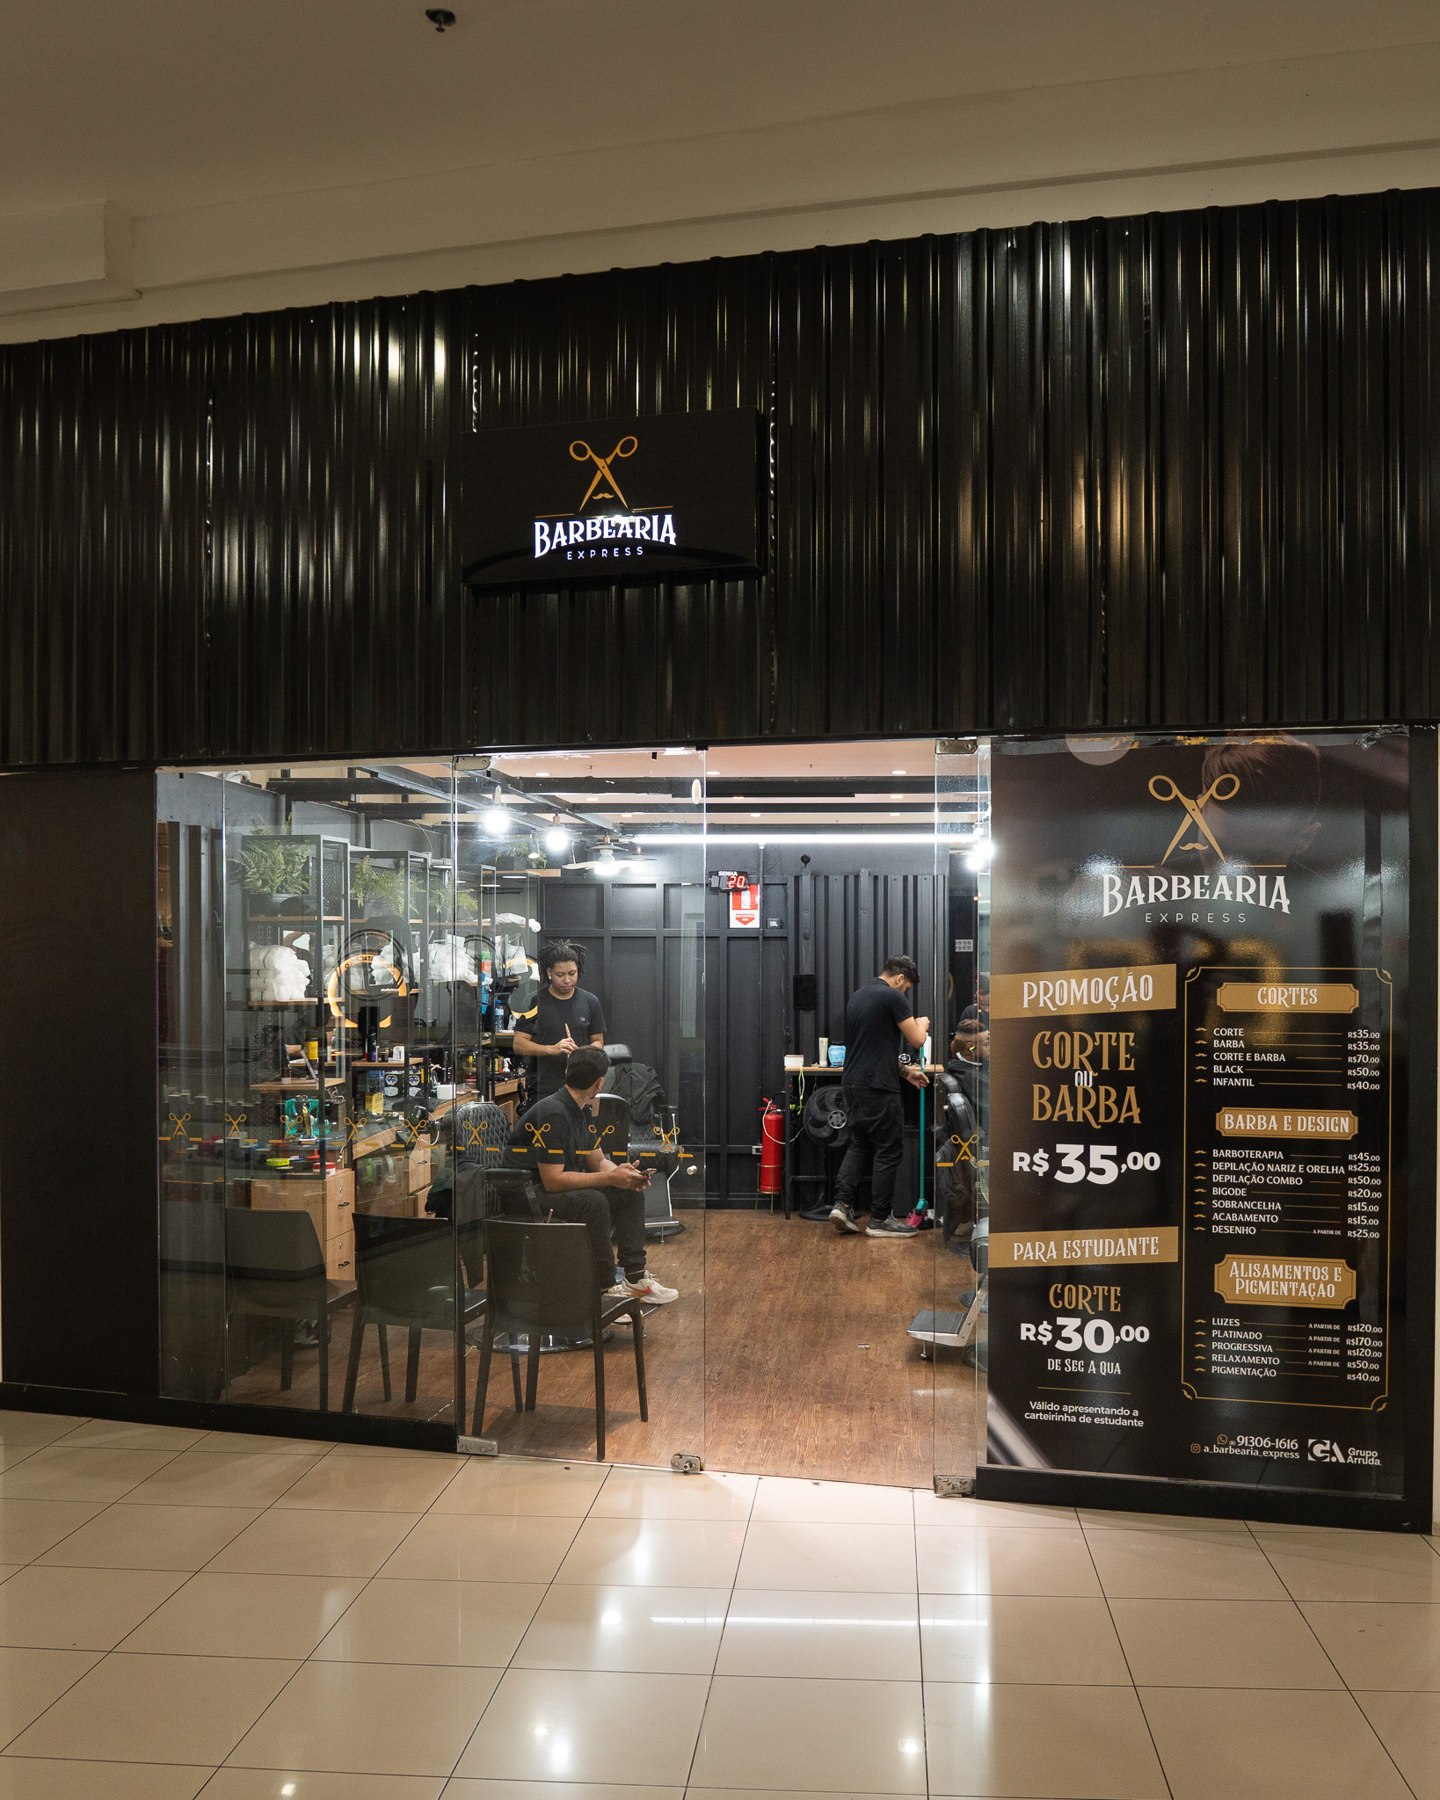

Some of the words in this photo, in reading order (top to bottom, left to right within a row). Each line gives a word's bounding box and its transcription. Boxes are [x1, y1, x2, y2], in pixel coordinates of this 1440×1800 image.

[534, 514, 677, 559] BARBEARIA
[566, 546, 643, 560] EXPRESS
[728, 876, 746, 888] 20
[1102, 874, 1291, 918] BARBEARIA
[1145, 912, 1246, 923] EXPRESS
[1257, 987, 1318, 1008] CORTES
[1213, 1028, 1244, 1037] CORTE
[1213, 1040, 1245, 1049] BARBA
[1032, 1031, 1135, 1076] CORTE
[1213, 1053, 1244, 1061] CORTE
[1246, 1053, 1252, 1061] E
[1254, 1053, 1286, 1062] BARBA
[1213, 1065, 1244, 1074] BLACK
[1074, 1070, 1093, 1088] OU
[1213, 1078, 1255, 1087] INFANTIL
[1032, 1083, 1142, 1129] BARBA
[1224, 1114, 1278, 1131] BARBA
[1283, 1115, 1292, 1131] E
[1297, 1116, 1350, 1133] DESIGN
[1212, 1149, 1284, 1160] BARBOTERAPIA
[1212, 1162, 1265, 1173] DEPILAÇÃO
[1267, 1164, 1296, 1173] NARIZ
[1299, 1165, 1304, 1173] E
[1306, 1165, 1345, 1175] ORELHA
[1212, 1174, 1265, 1185] DEPILAÇÃO
[1266, 1176, 1303, 1185] COMBO
[1212, 1187, 1247, 1197] BIGODE
[1212, 1200, 1282, 1211] SOBRANCELHA
[1212, 1212, 1279, 1223] ACABAMENTO
[1212, 1225, 1256, 1235] DESENHO
[1013, 1241, 1057, 1263] PARA
[1063, 1236, 1159, 1259] ESTUDANTE
[1229, 1261, 1329, 1281] ALISAMENTOS
[1334, 1267, 1342, 1282] E
[1049, 1284, 1121, 1315] CORTE
[1212, 1318, 1240, 1327] LUZES
[1020, 1316, 1150, 1354] R$30,00
[1212, 1330, 1263, 1340] PLATINADO
[1212, 1341, 1273, 1353] PROGRESSIVA
[1212, 1354, 1280, 1365] RELAXAMENTO
[1047, 1358, 1061, 1371] DE
[1064, 1359, 1084, 1373] SEG
[1088, 1360, 1096, 1374] A
[1099, 1361, 1121, 1376] QUA
[1211, 1365, 1277, 1378] PIGMENTAÇÃO
[1029, 1401, 1060, 1411] Válido
[1062, 1403, 1130, 1416] apresentando
[1024, 1412, 1076, 1423] carteirinha
[1079, 1414, 1092, 1423] de
[1094, 1416, 1144, 1427] estudante
[1237, 1435, 1299, 1450] 91306-1616
[1348, 1447, 1378, 1458] Grupo
